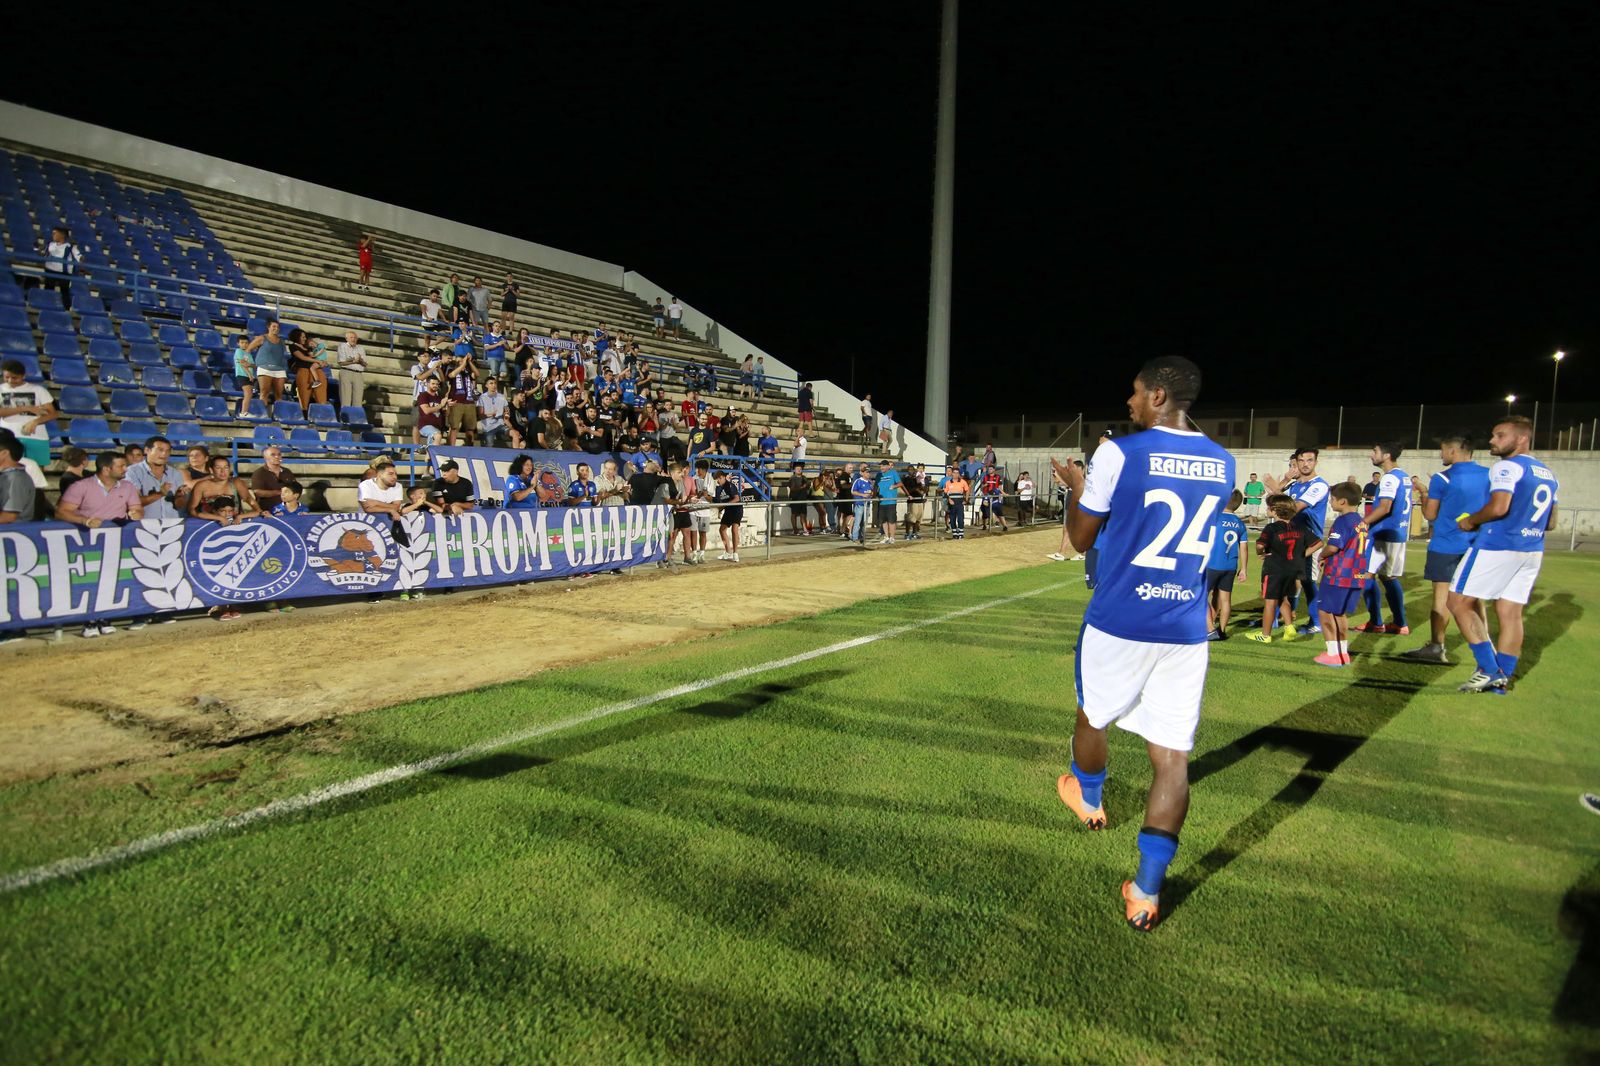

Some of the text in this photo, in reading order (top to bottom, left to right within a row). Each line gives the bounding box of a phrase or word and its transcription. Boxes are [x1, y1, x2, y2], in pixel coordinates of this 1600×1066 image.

[1149, 456, 1226, 479] RANABE
[1530, 483, 1552, 522] 9
[433, 510, 553, 579] FROM
[1130, 488, 1222, 574] 24
[1223, 529, 1238, 554] 9
[225, 529, 271, 584] XEREZ
[1285, 538, 1296, 561] 7
[0, 527, 130, 623] REZ
[210, 570, 298, 599] DEPORTIVO
[336, 575, 376, 583] ULTRAS
